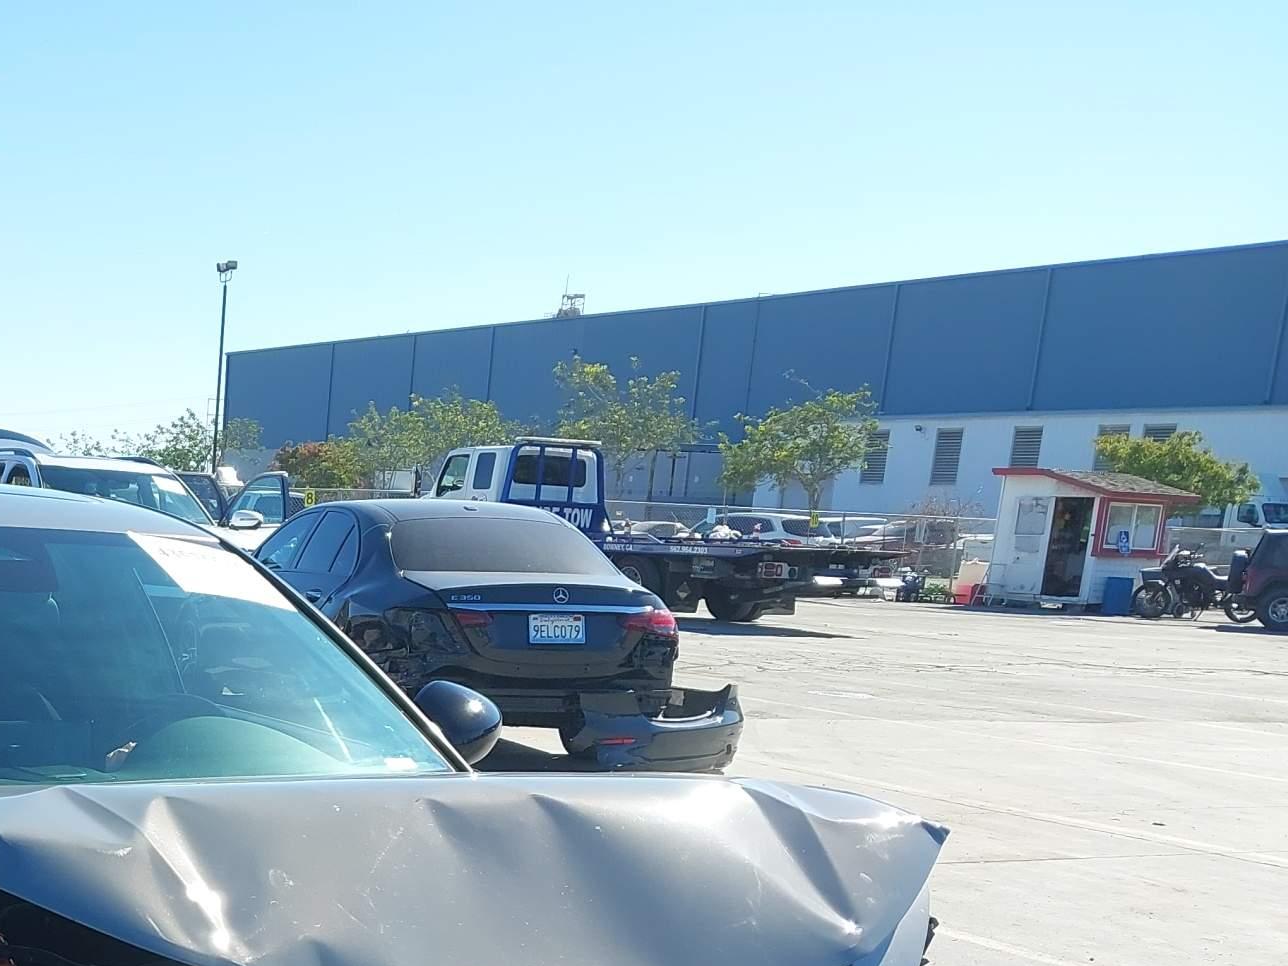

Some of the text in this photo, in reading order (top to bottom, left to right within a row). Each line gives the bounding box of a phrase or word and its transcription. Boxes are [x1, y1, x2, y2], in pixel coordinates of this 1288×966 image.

[306, 492, 313, 505] 8
[563, 507, 593, 529] TOW
[532, 624, 581, 639] 9ELC079
